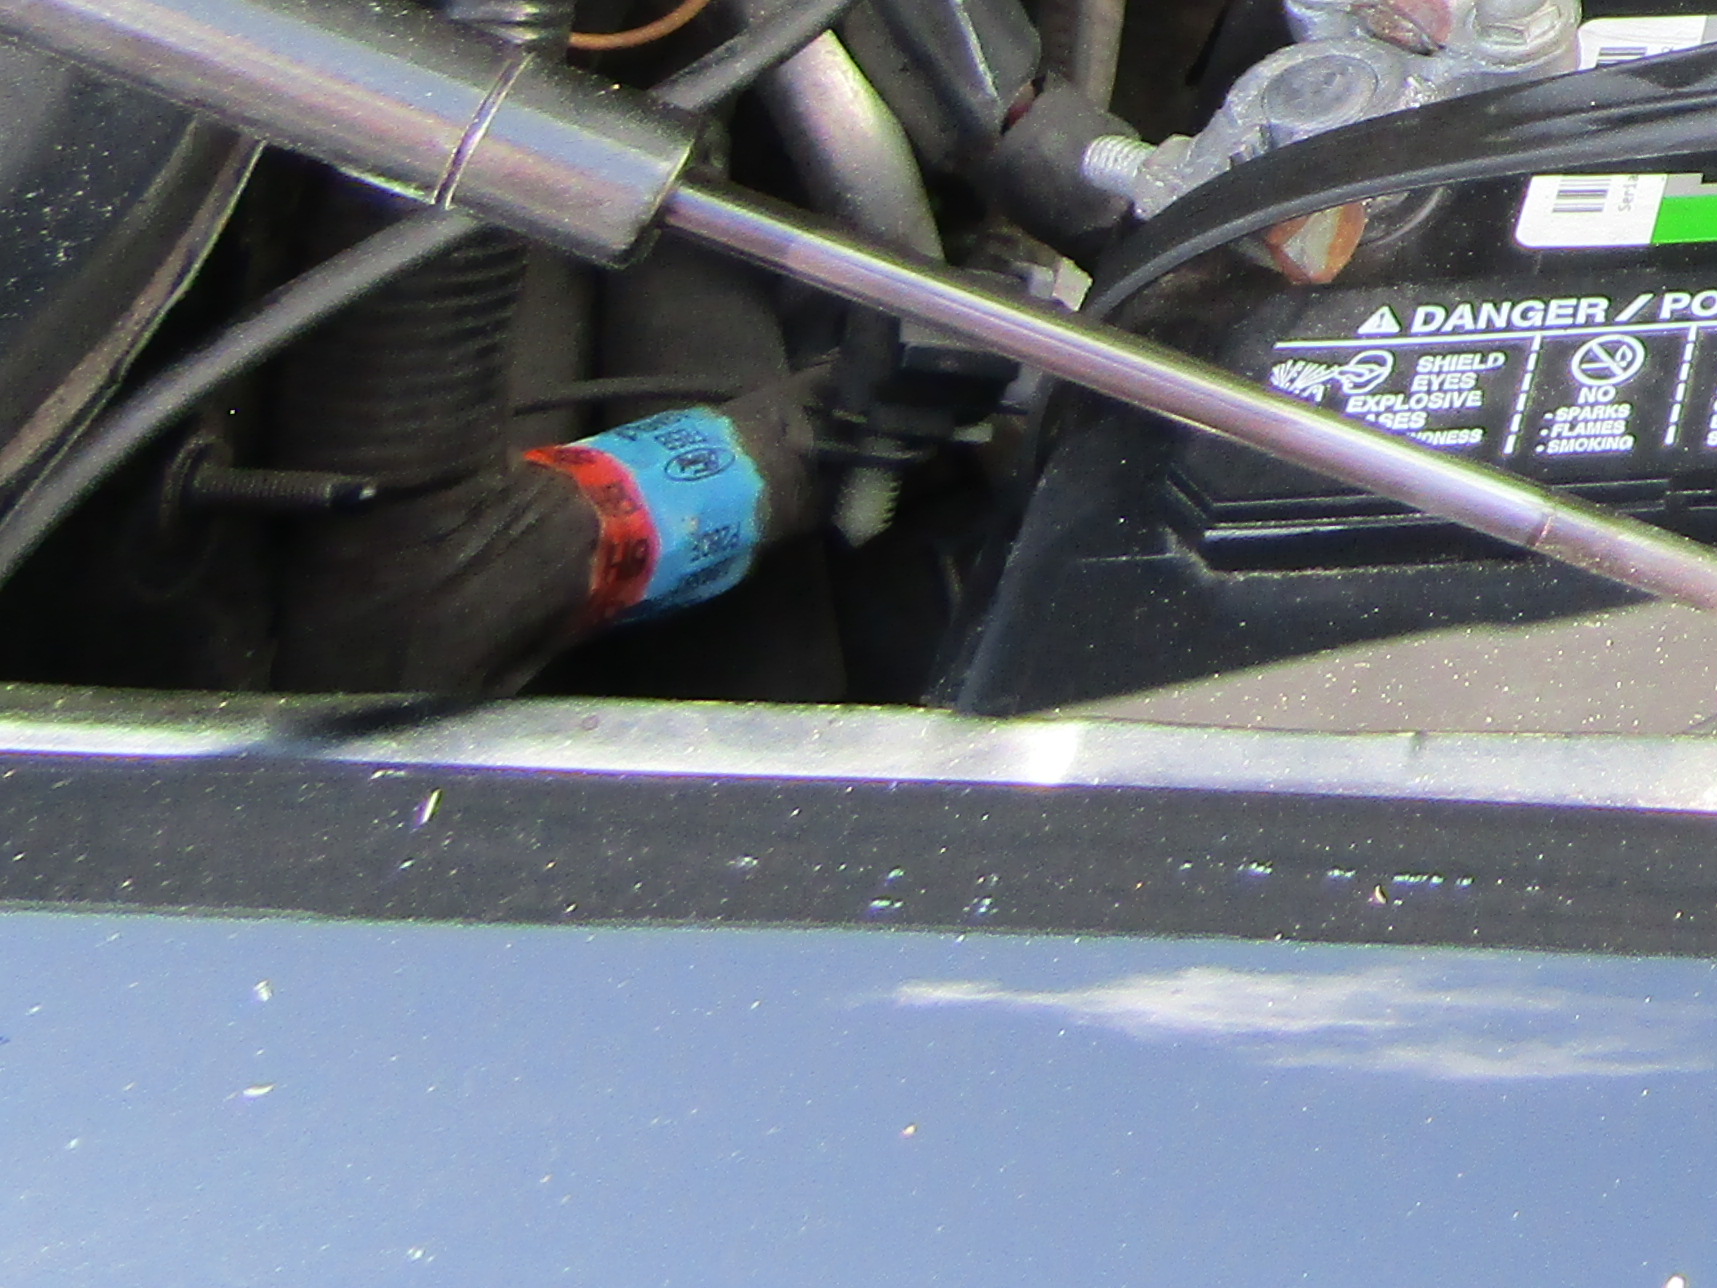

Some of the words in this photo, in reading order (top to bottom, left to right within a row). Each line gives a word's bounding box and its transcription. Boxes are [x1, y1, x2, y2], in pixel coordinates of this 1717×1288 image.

[1410, 296, 1612, 335] DANGER
[1415, 351, 1507, 374] SHIELD
[1410, 372, 1479, 393] EYES
[1345, 390, 1484, 414] EXPLOSIVE
[1576, 385, 1618, 404] NO
[1554, 403, 1633, 422] SPARKS
[1549, 420, 1628, 438] FLAMES
[1545, 435, 1636, 456] SMOKING
